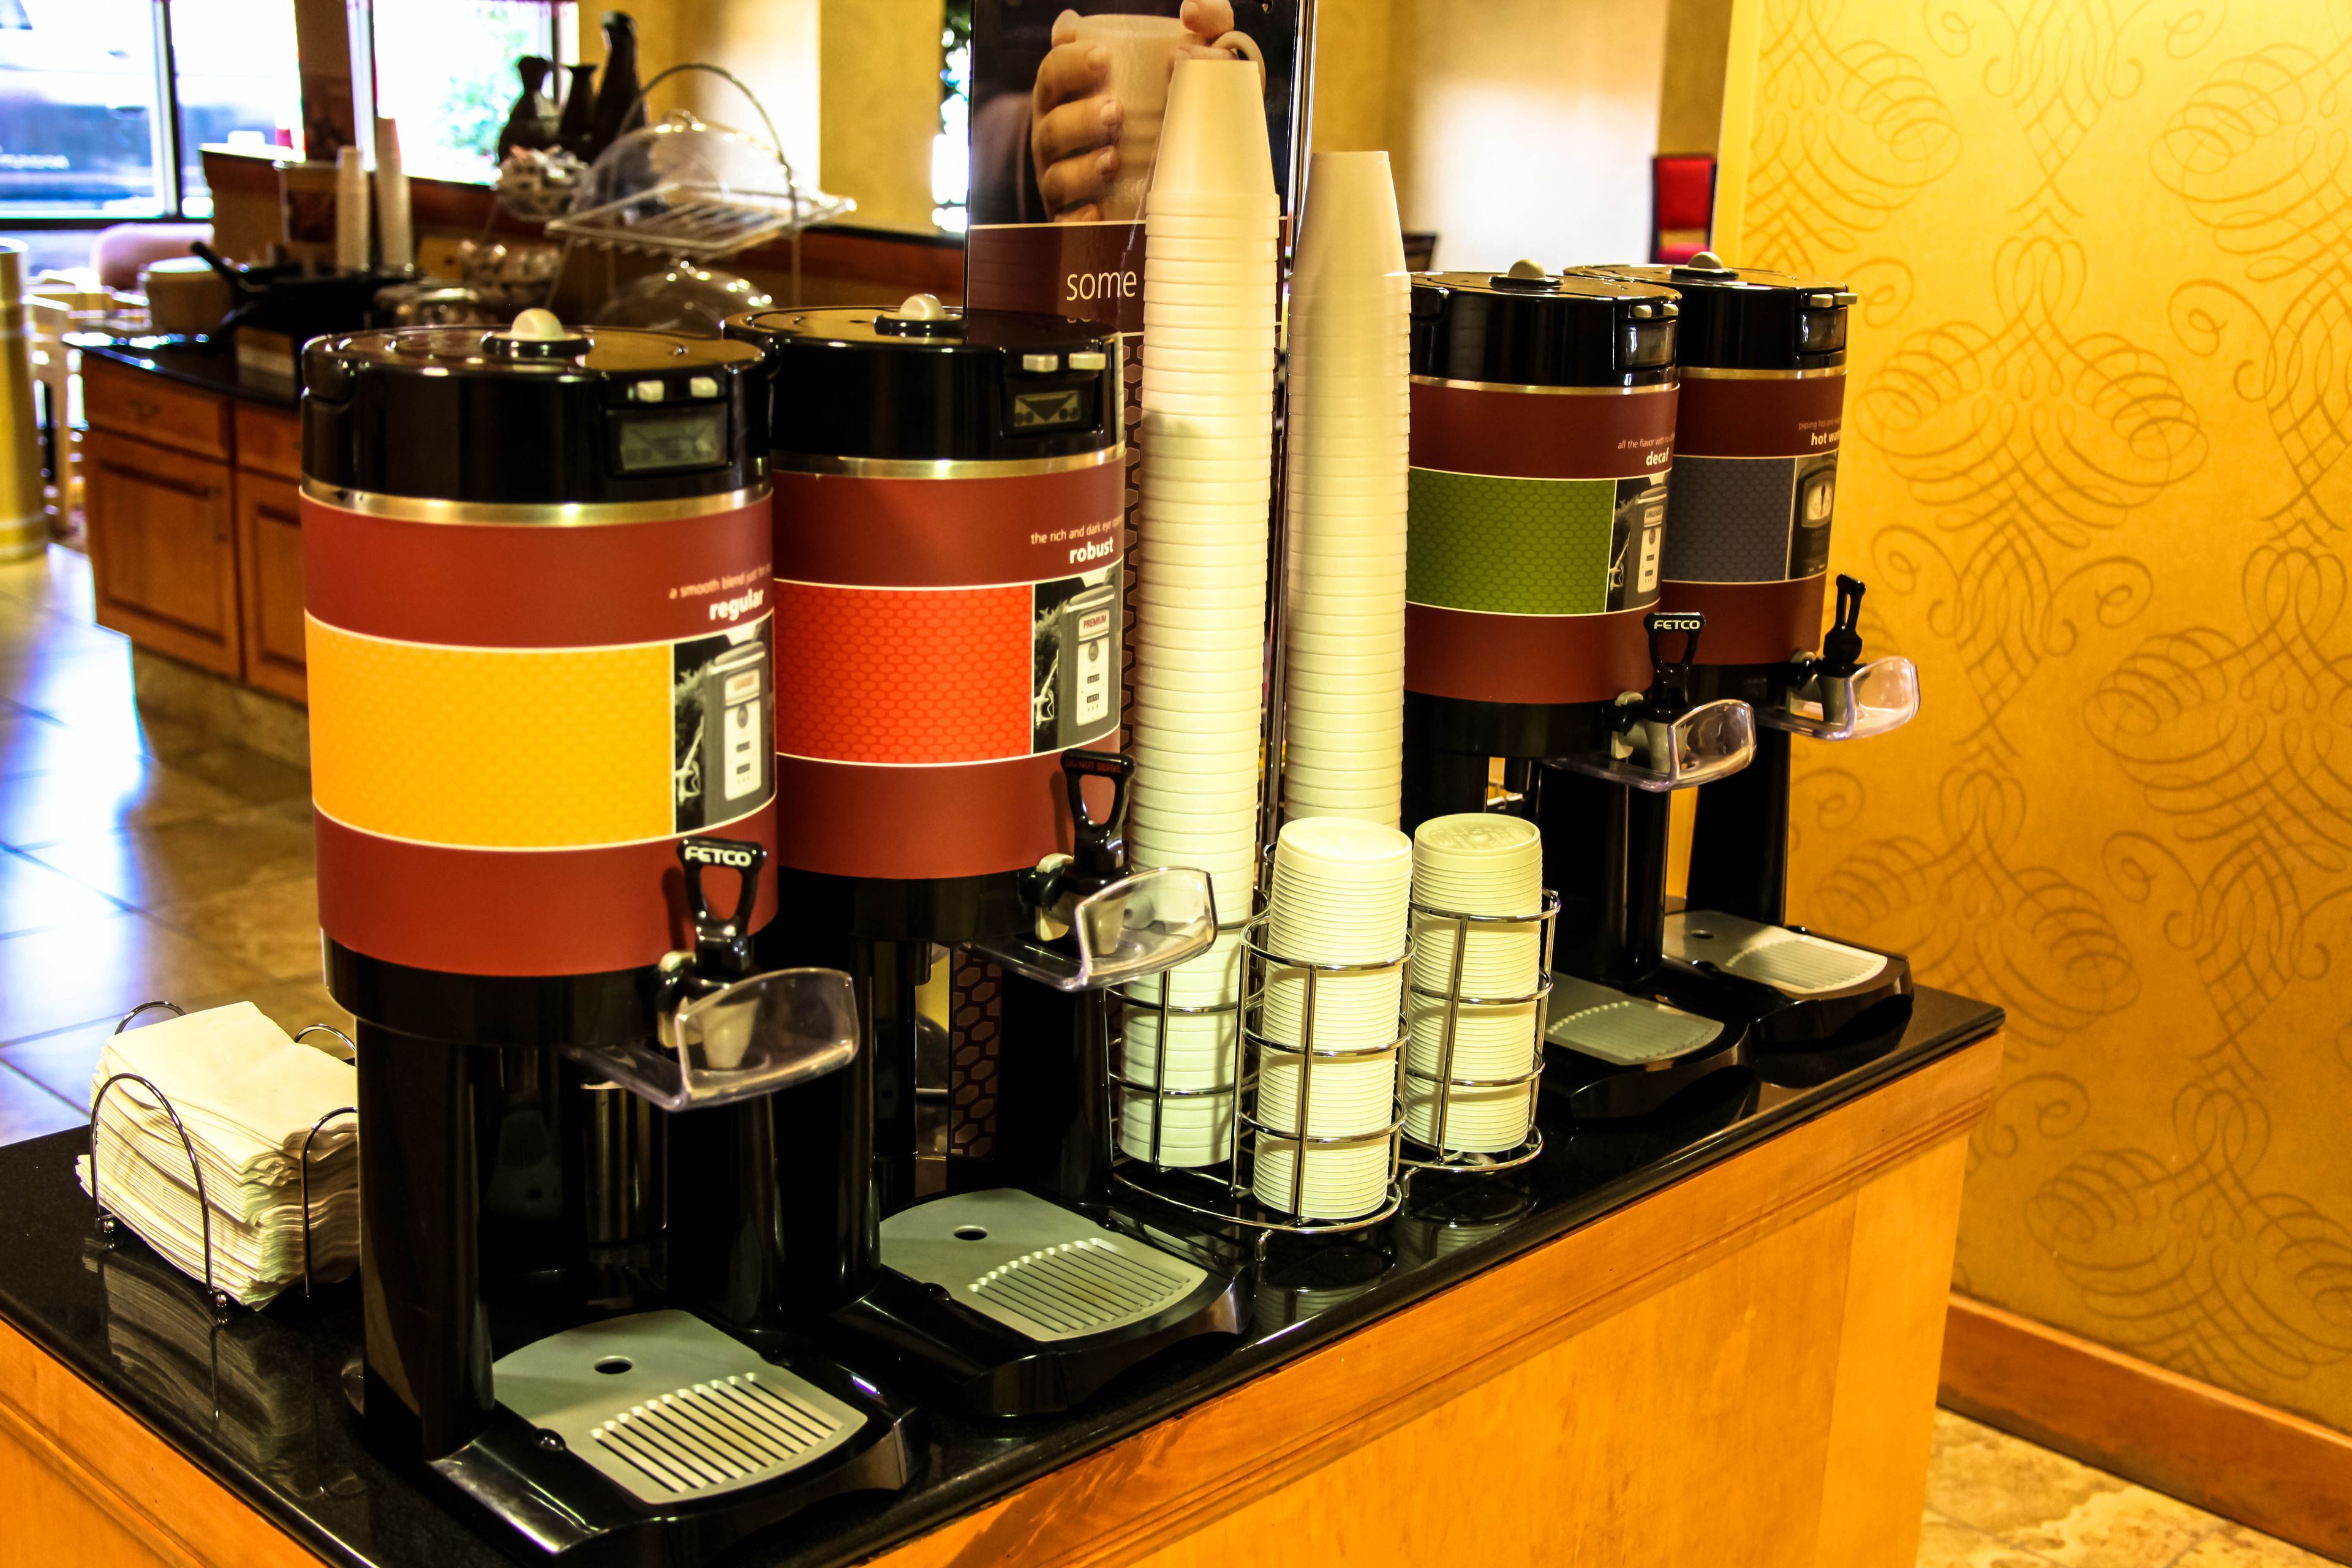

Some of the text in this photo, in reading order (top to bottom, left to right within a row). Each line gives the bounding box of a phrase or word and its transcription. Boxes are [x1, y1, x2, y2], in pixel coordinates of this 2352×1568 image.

[1066, 271, 1137, 301] some
[1627, 439, 1638, 449] the
[1640, 437, 1654, 447] flavor
[1811, 432, 1827, 446] hot
[1646, 447, 1669, 466] decaf
[1031, 532, 1047, 545] the
[1050, 528, 1066, 542] rich
[1069, 525, 1085, 540] and
[1086, 522, 1101, 536] dark
[1102, 521, 1112, 533] eye
[1069, 536, 1114, 564] robust
[669, 588, 677, 599] a
[680, 578, 720, 598] smooth
[709, 587, 764, 621] regular
[1084, 613, 1106, 629] PREMIUM
[1654, 619, 1700, 630] FETCO
[1079, 761, 1094, 770] NOT
[684, 845, 752, 867] FETCO
